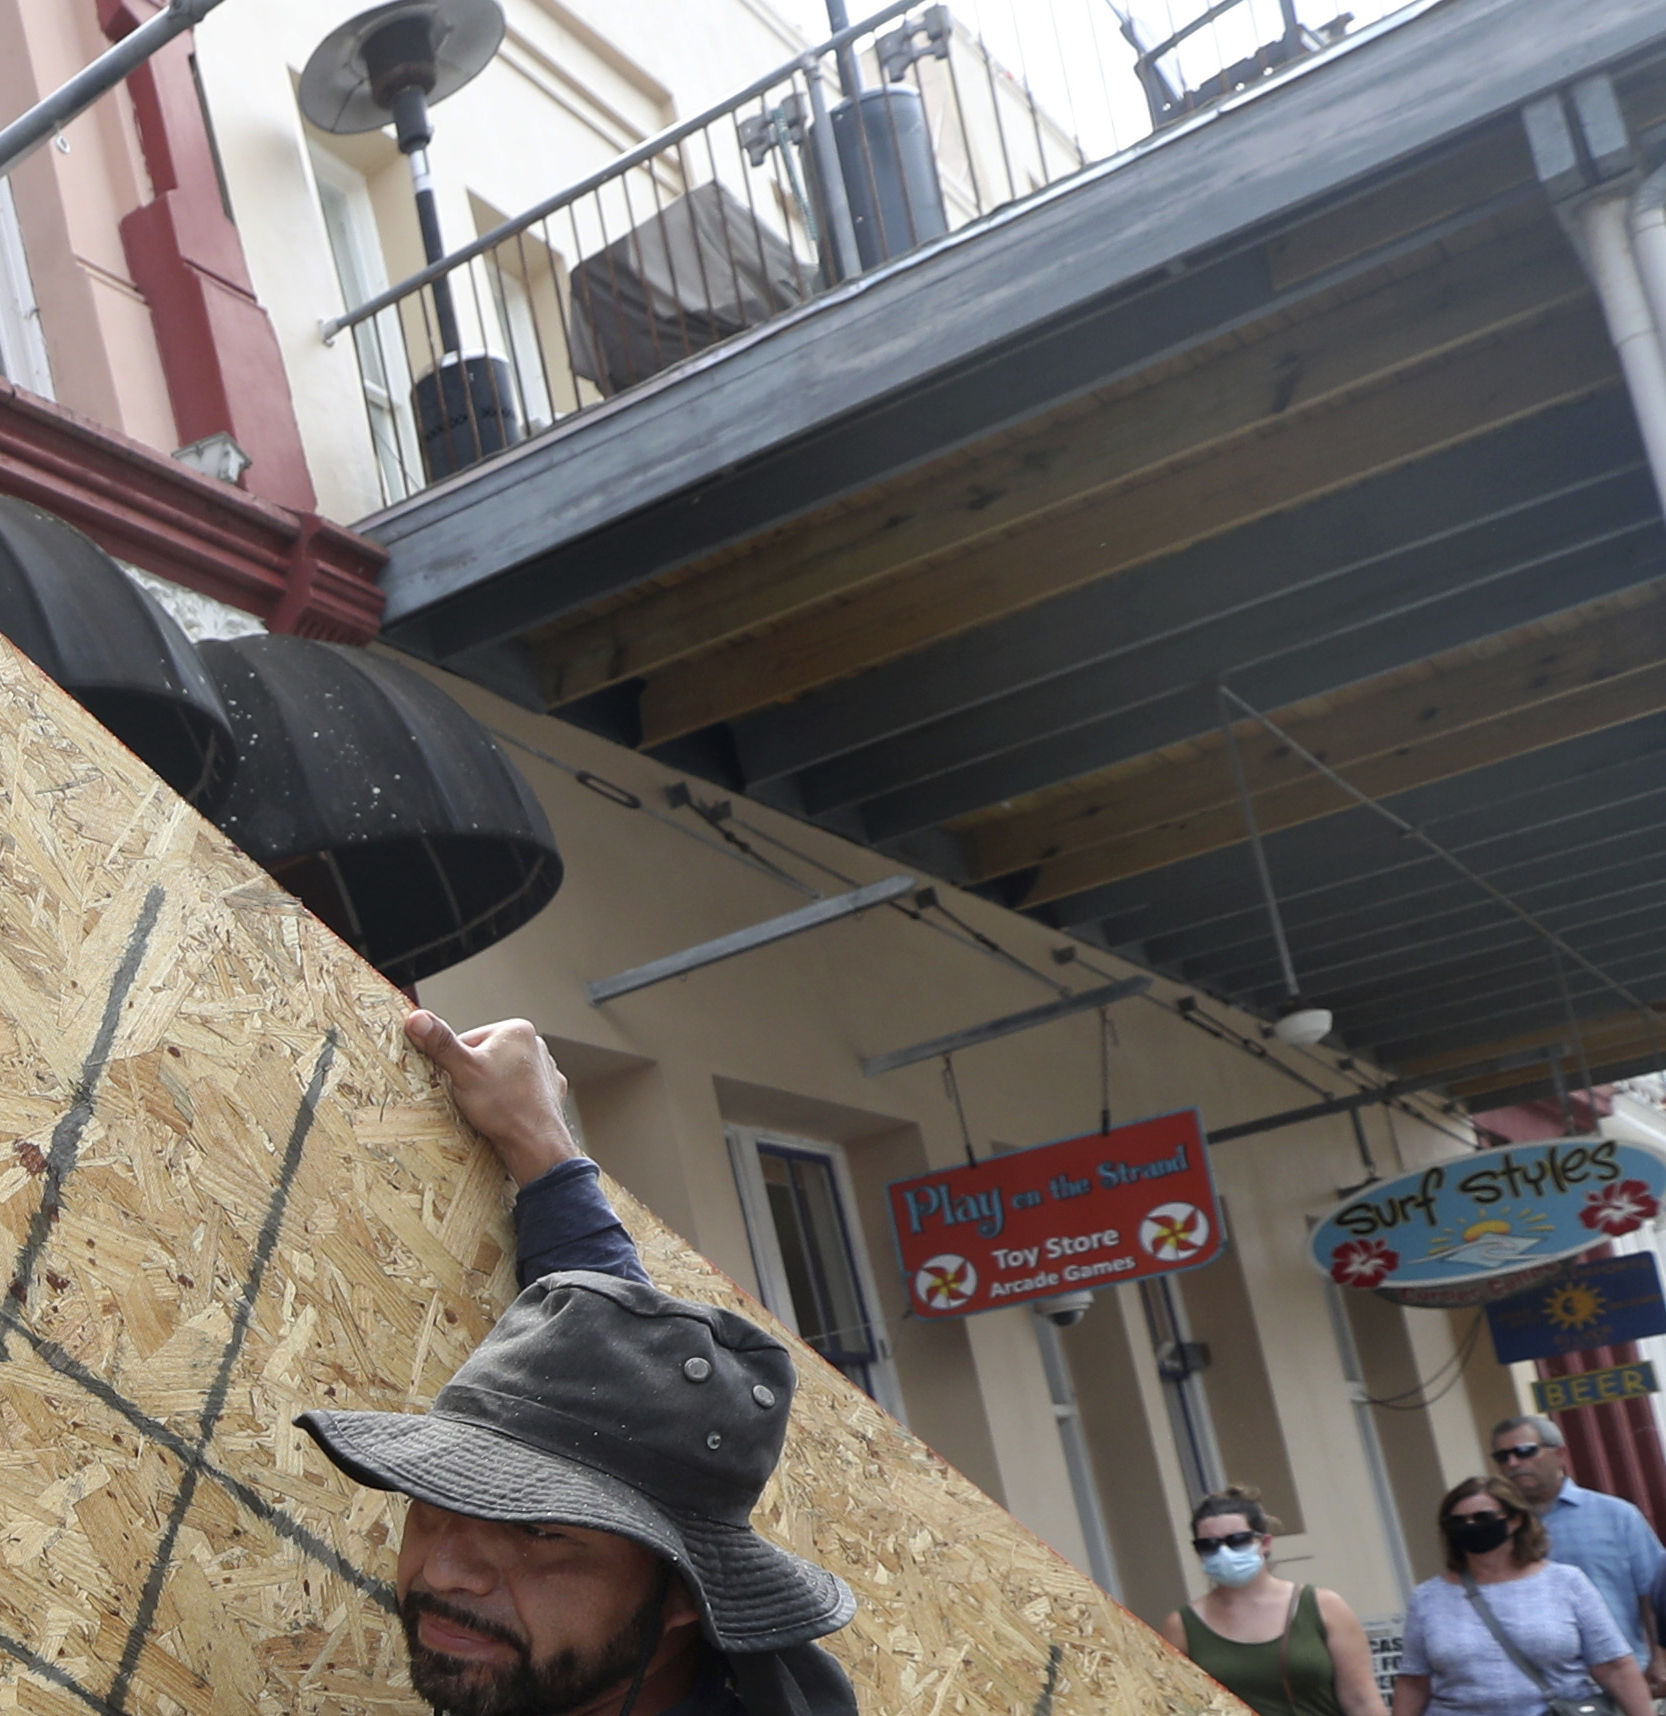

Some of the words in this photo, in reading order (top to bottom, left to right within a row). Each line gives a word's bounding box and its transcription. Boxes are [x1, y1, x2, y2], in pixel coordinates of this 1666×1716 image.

[903, 1182, 1005, 1240] Play
[1012, 1189, 1043, 1211] on
[1049, 1173, 1092, 1200] the
[1097, 1144, 1190, 1189] Strand
[1335, 1167, 1446, 1236] Surf
[1458, 1140, 1621, 1205] Styles
[992, 1246, 1040, 1271] Toy
[1046, 1228, 1120, 1260] Store
[990, 1270, 1060, 1298] Arcade
[1063, 1255, 1136, 1282] Games
[1545, 1369, 1647, 1407] BEER
